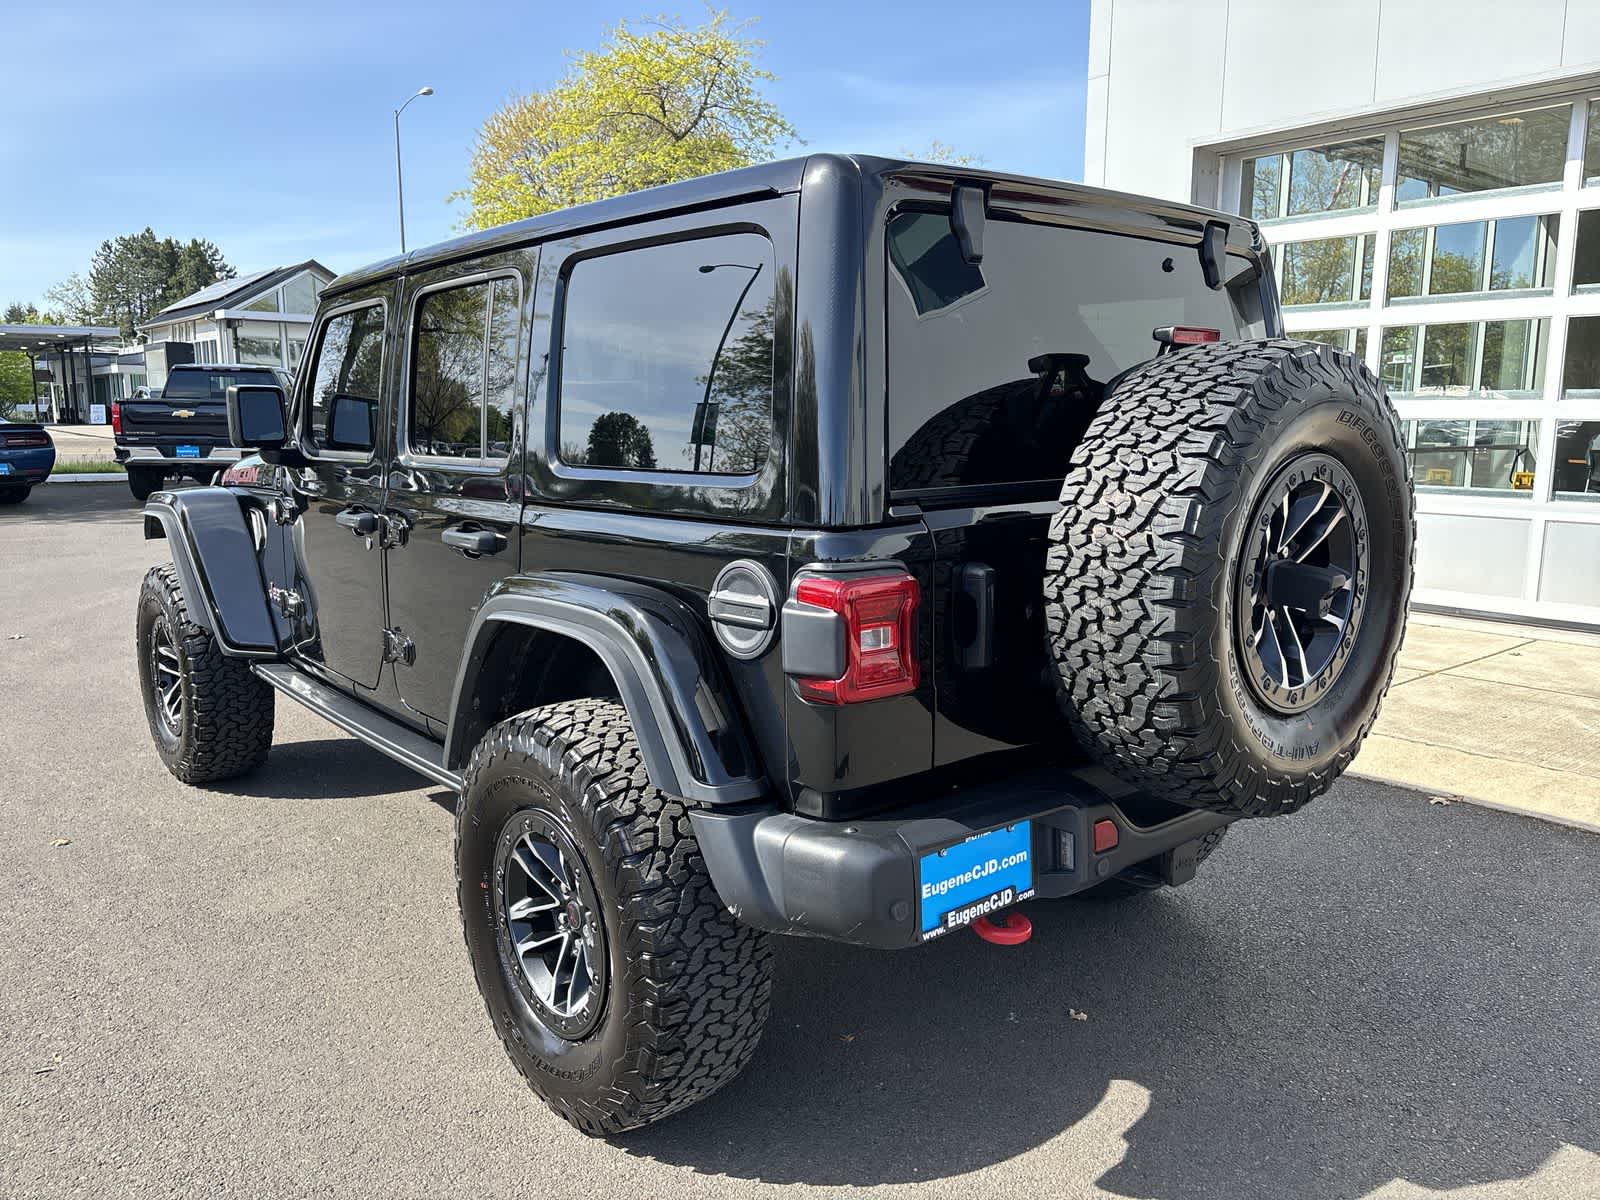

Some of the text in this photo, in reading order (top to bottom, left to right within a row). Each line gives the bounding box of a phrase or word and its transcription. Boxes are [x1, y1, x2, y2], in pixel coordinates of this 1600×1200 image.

[921, 850, 1028, 899] EugeneCJD.com
[922, 926, 946, 941] www.
[947, 888, 1013, 928] EugeneCJD
